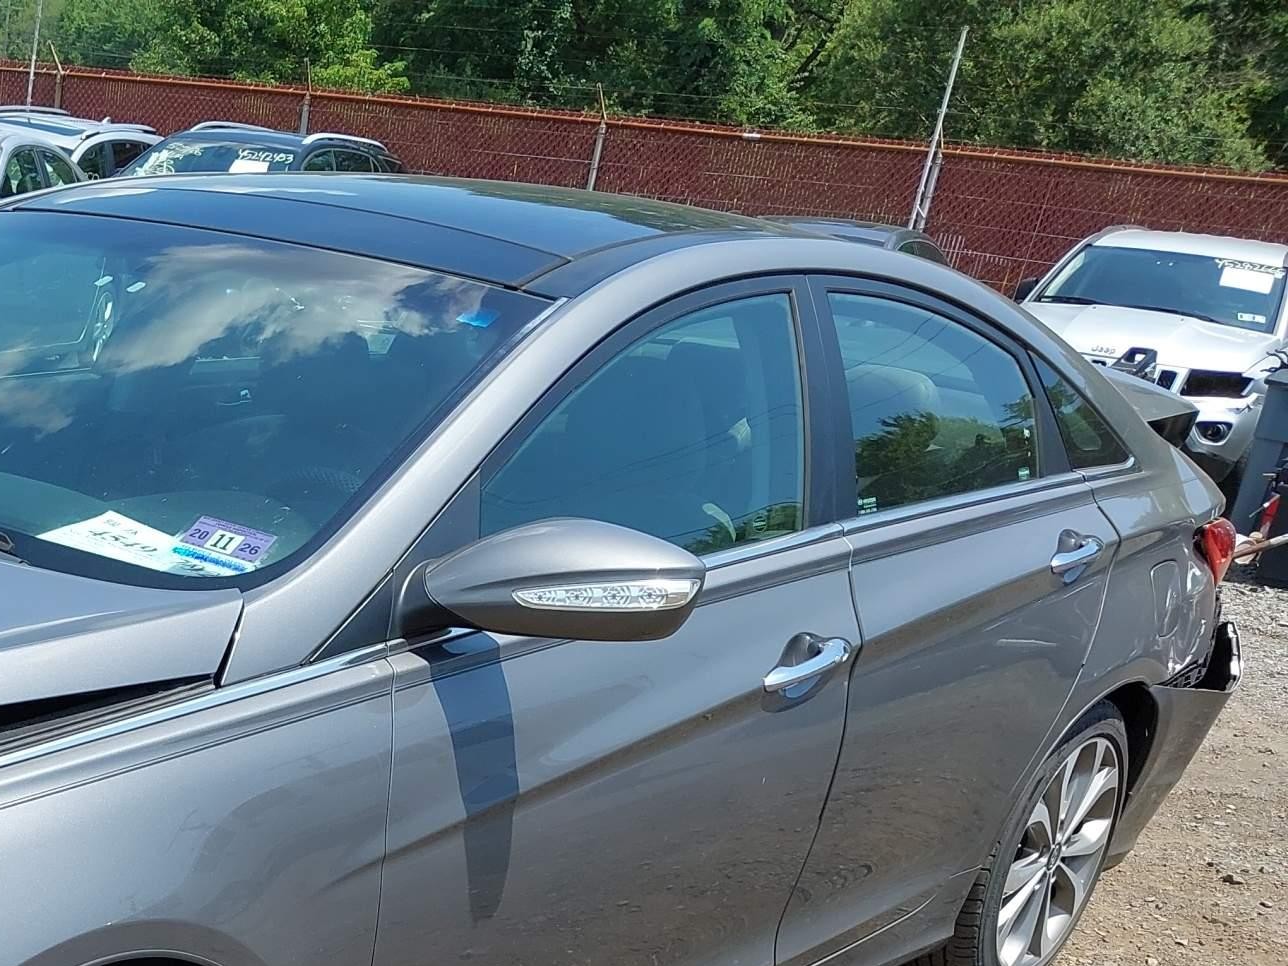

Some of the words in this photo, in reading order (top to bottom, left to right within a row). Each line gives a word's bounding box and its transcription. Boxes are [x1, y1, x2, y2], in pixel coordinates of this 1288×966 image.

[188, 527, 210, 541] 20
[210, 532, 232, 551] 11
[238, 542, 259, 556] 26
